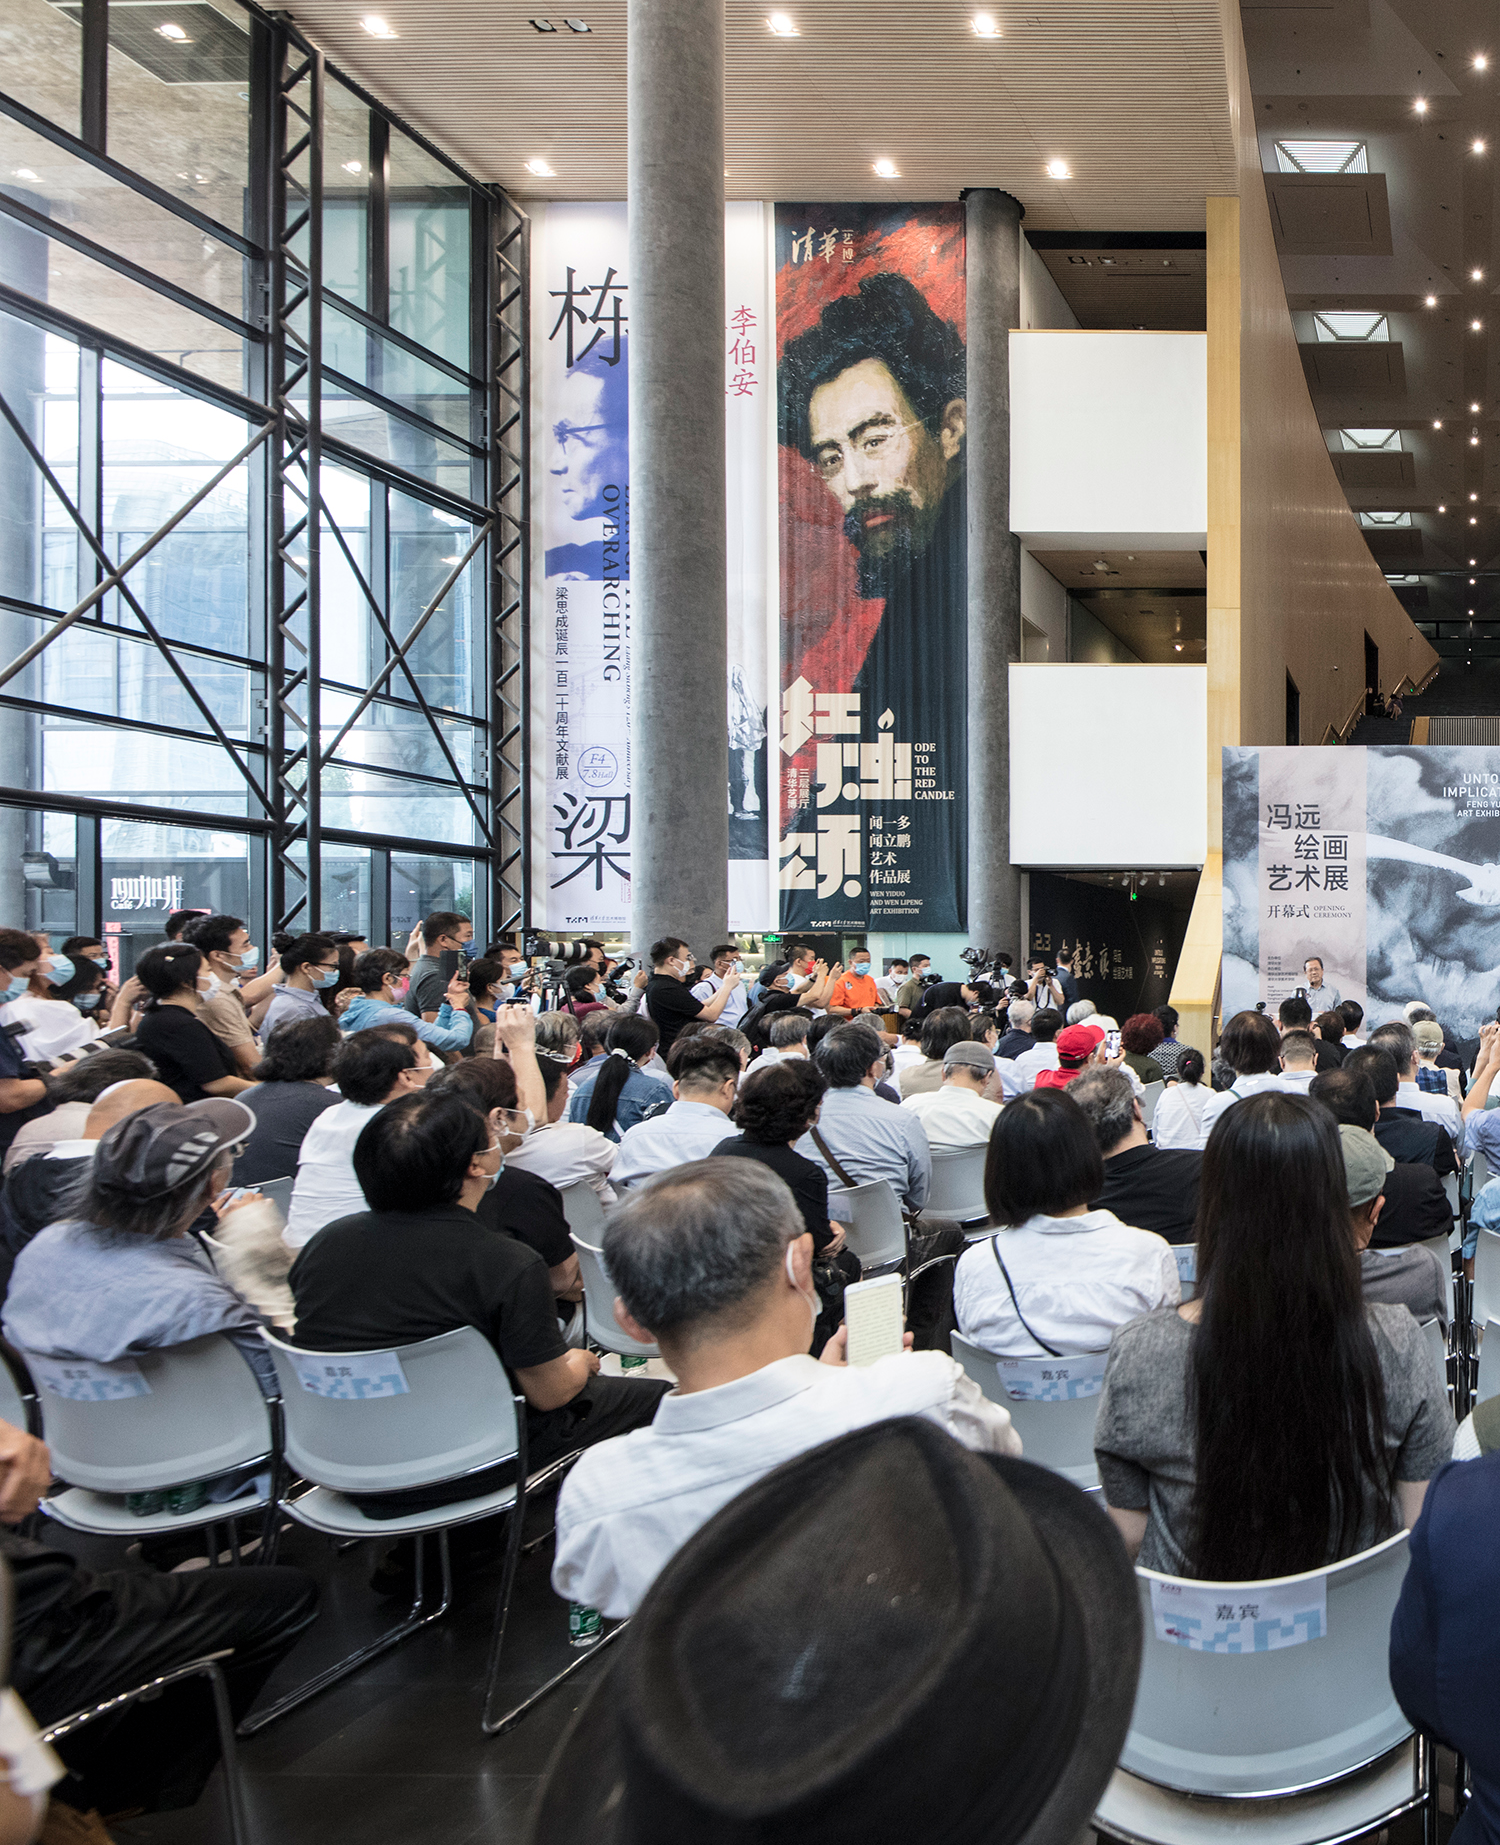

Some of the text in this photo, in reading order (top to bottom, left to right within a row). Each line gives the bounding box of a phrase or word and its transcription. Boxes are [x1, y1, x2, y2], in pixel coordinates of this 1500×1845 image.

[728, 305, 759, 396] 李伯安
[602, 484, 621, 682] OVERARCHING
[555, 587, 569, 780] 梁思成诞辰一百二十周年文献展
[914, 743, 936, 752] ODE
[914, 755, 929, 764] TO
[914, 767, 936, 776] THE
[914, 779, 936, 788] RED
[914, 790, 955, 800] CANDLE
[869, 815, 911, 831] 闻一多
[1267, 803, 1320, 830] 冯远
[550, 792, 631, 891] 梁
[869, 833, 911, 848] 闻立鹏
[1294, 833, 1349, 861] 绘画
[869, 851, 897, 866] 艺术
[869, 869, 911, 884] 作品展
[1267, 864, 1349, 892] 艺术展
[1267, 904, 1310, 919] 开幕式
[1215, 1603, 1261, 1621] 嘉宾
